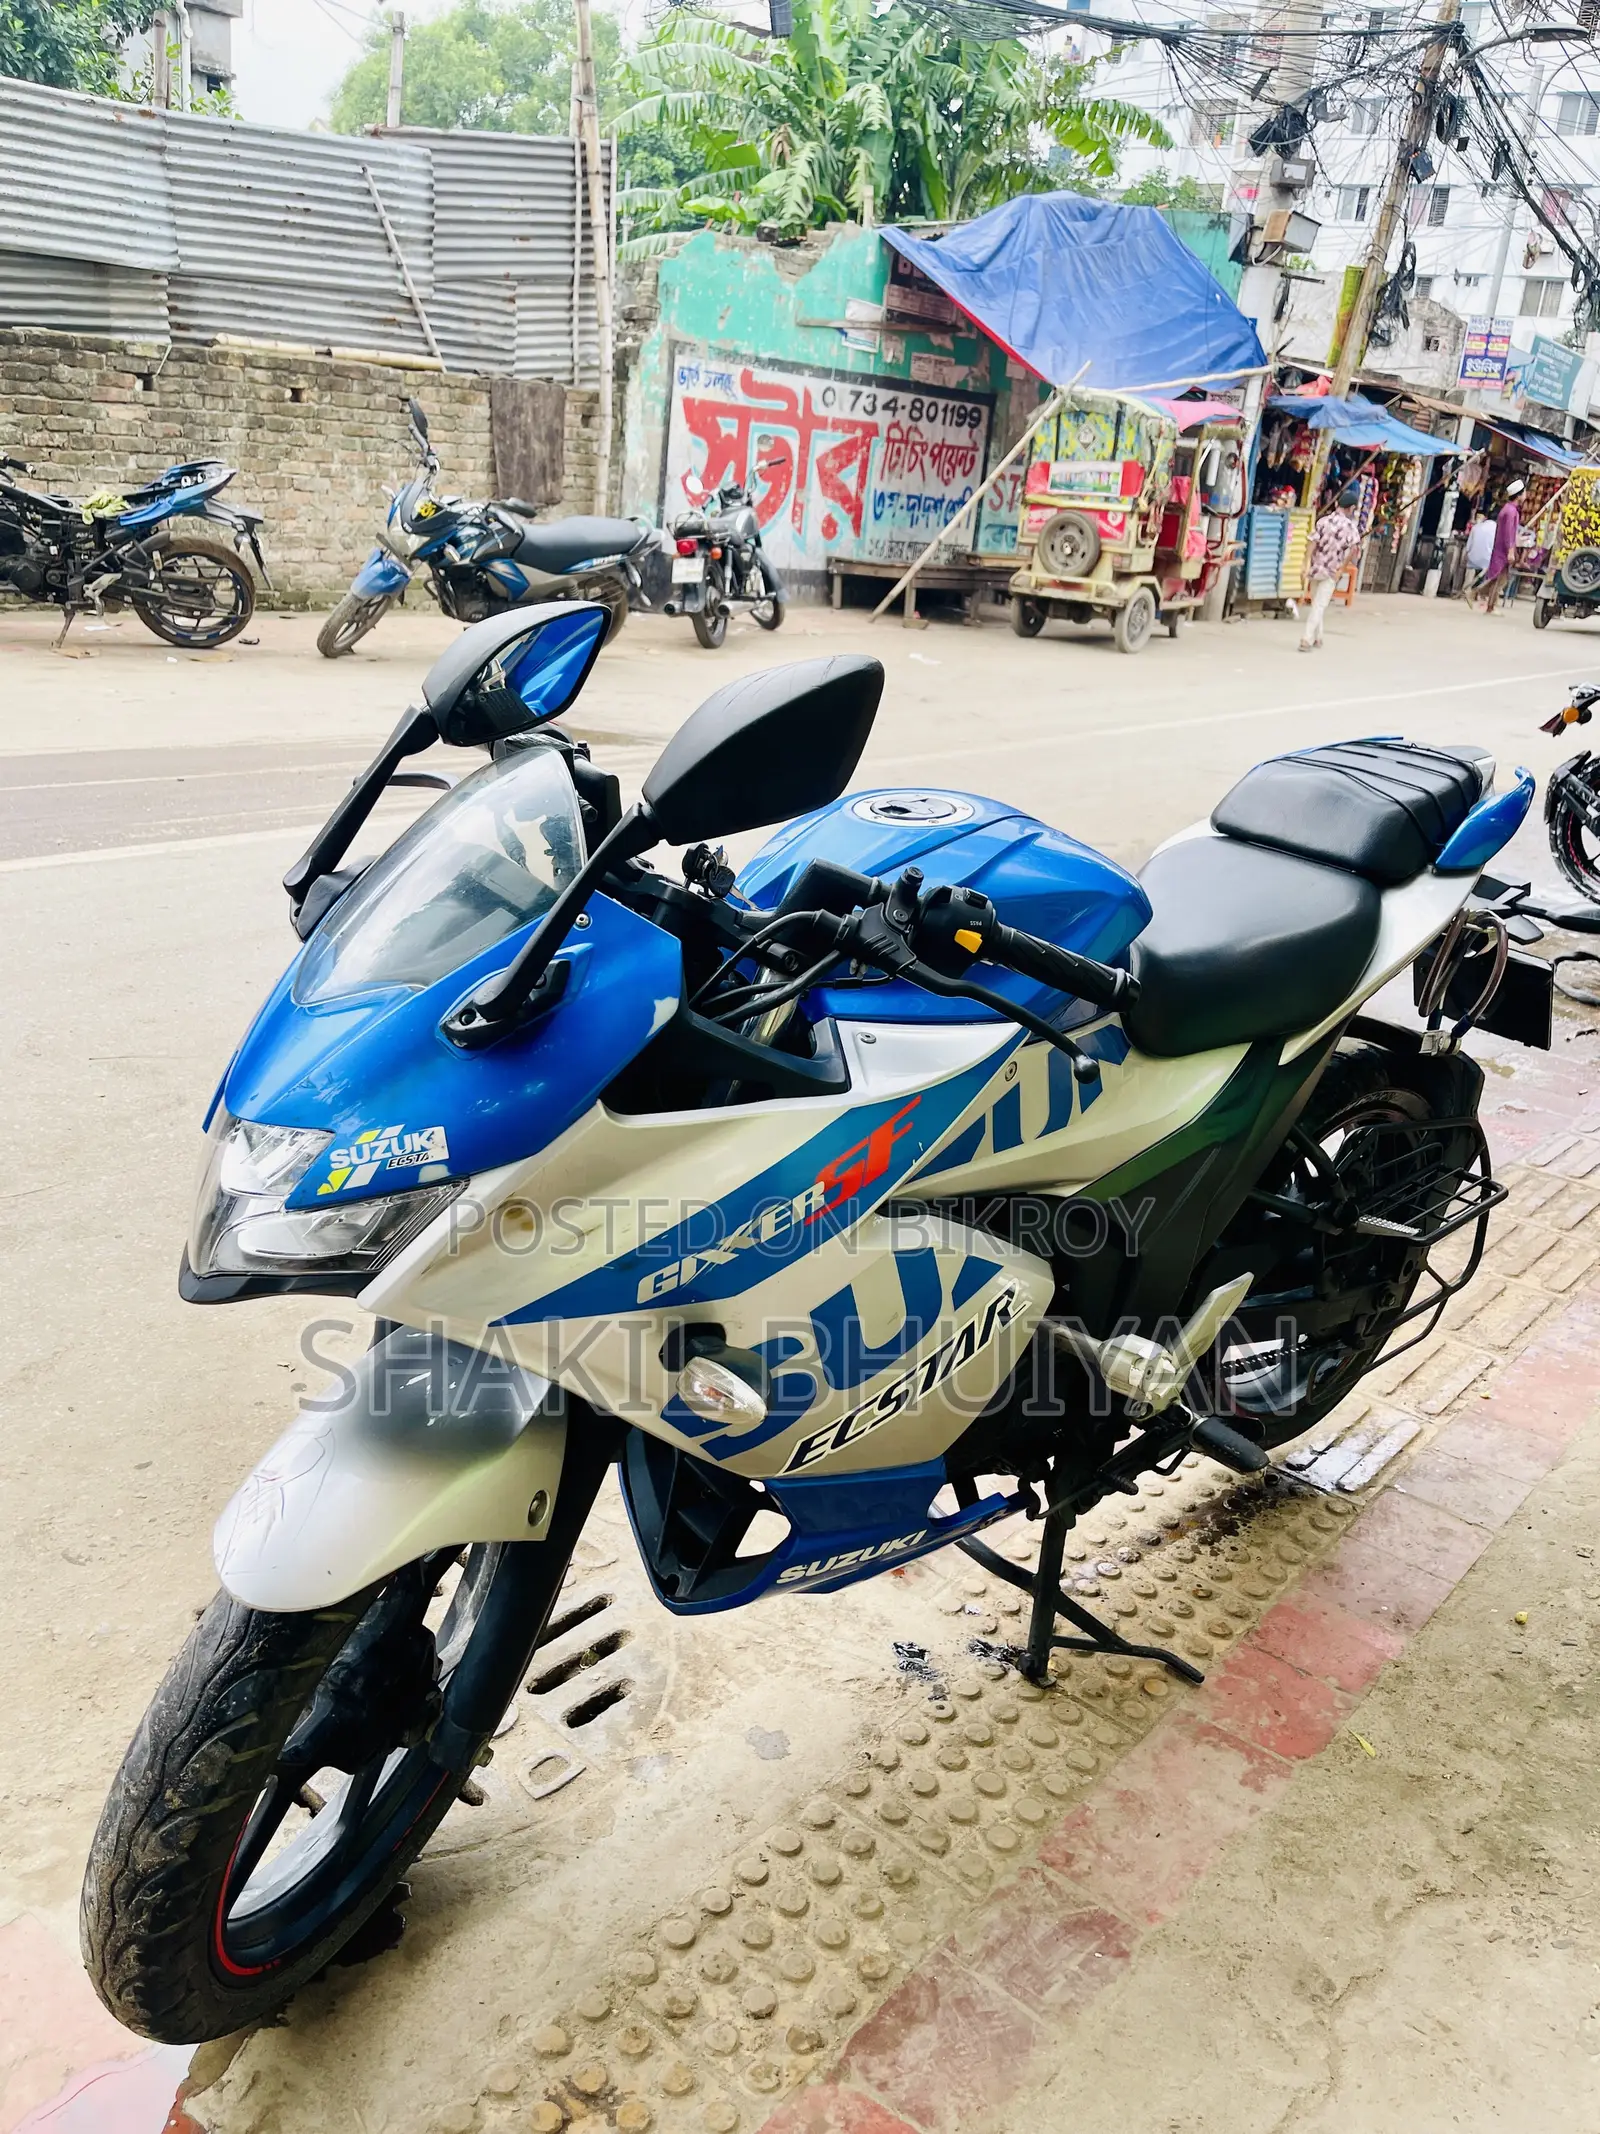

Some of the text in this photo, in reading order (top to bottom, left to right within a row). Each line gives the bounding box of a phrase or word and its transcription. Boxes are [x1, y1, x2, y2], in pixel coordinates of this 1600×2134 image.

[329, 1130, 438, 1170] SUZUK
[387, 1151, 430, 1169] ECSTA
[804, 1095, 922, 1226] SF
[780, 1278, 1031, 1474] ECSTAR
[776, 1530, 927, 1585] SUZUKI
